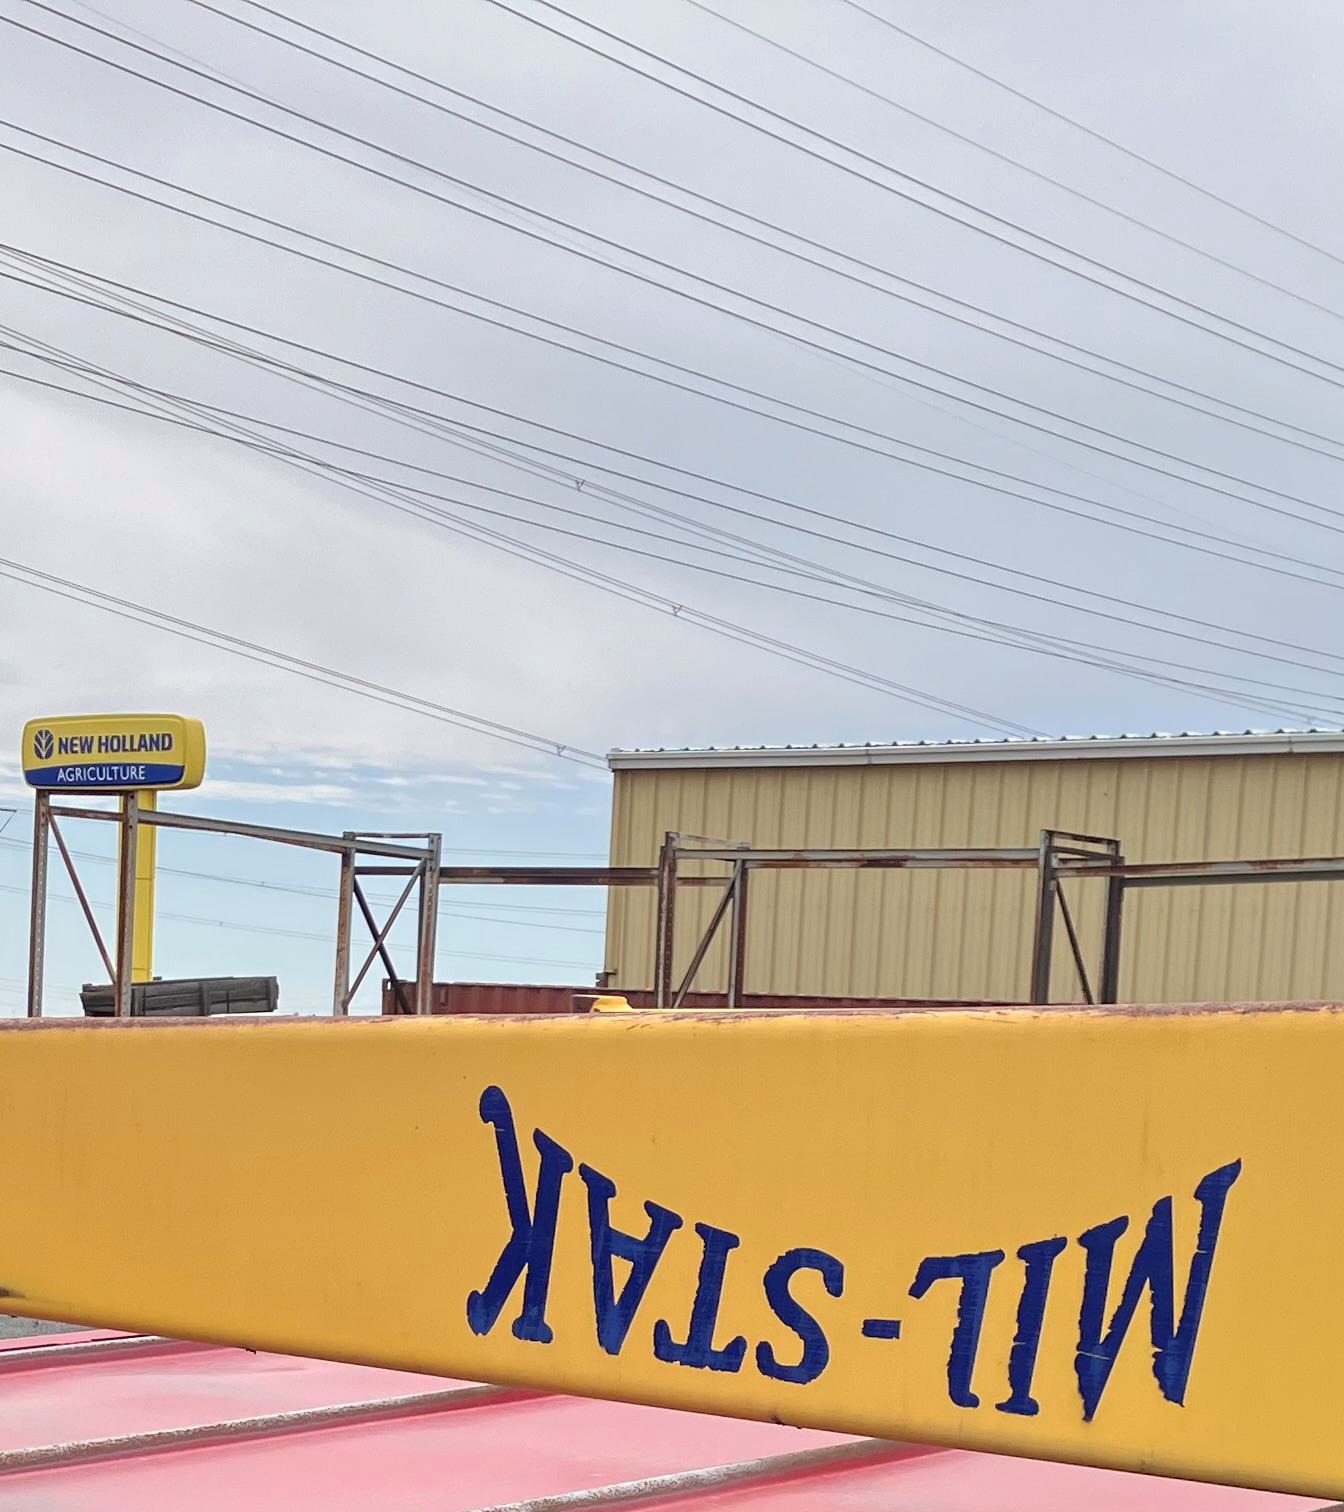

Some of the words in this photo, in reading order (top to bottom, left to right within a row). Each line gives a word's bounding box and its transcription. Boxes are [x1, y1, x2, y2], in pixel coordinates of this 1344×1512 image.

[58, 736, 94, 755] NEW
[97, 733, 173, 753] HOLLAND
[57, 765, 146, 782] AGRICULTURE
[467, 1085, 1242, 1422] MIL-STAK
